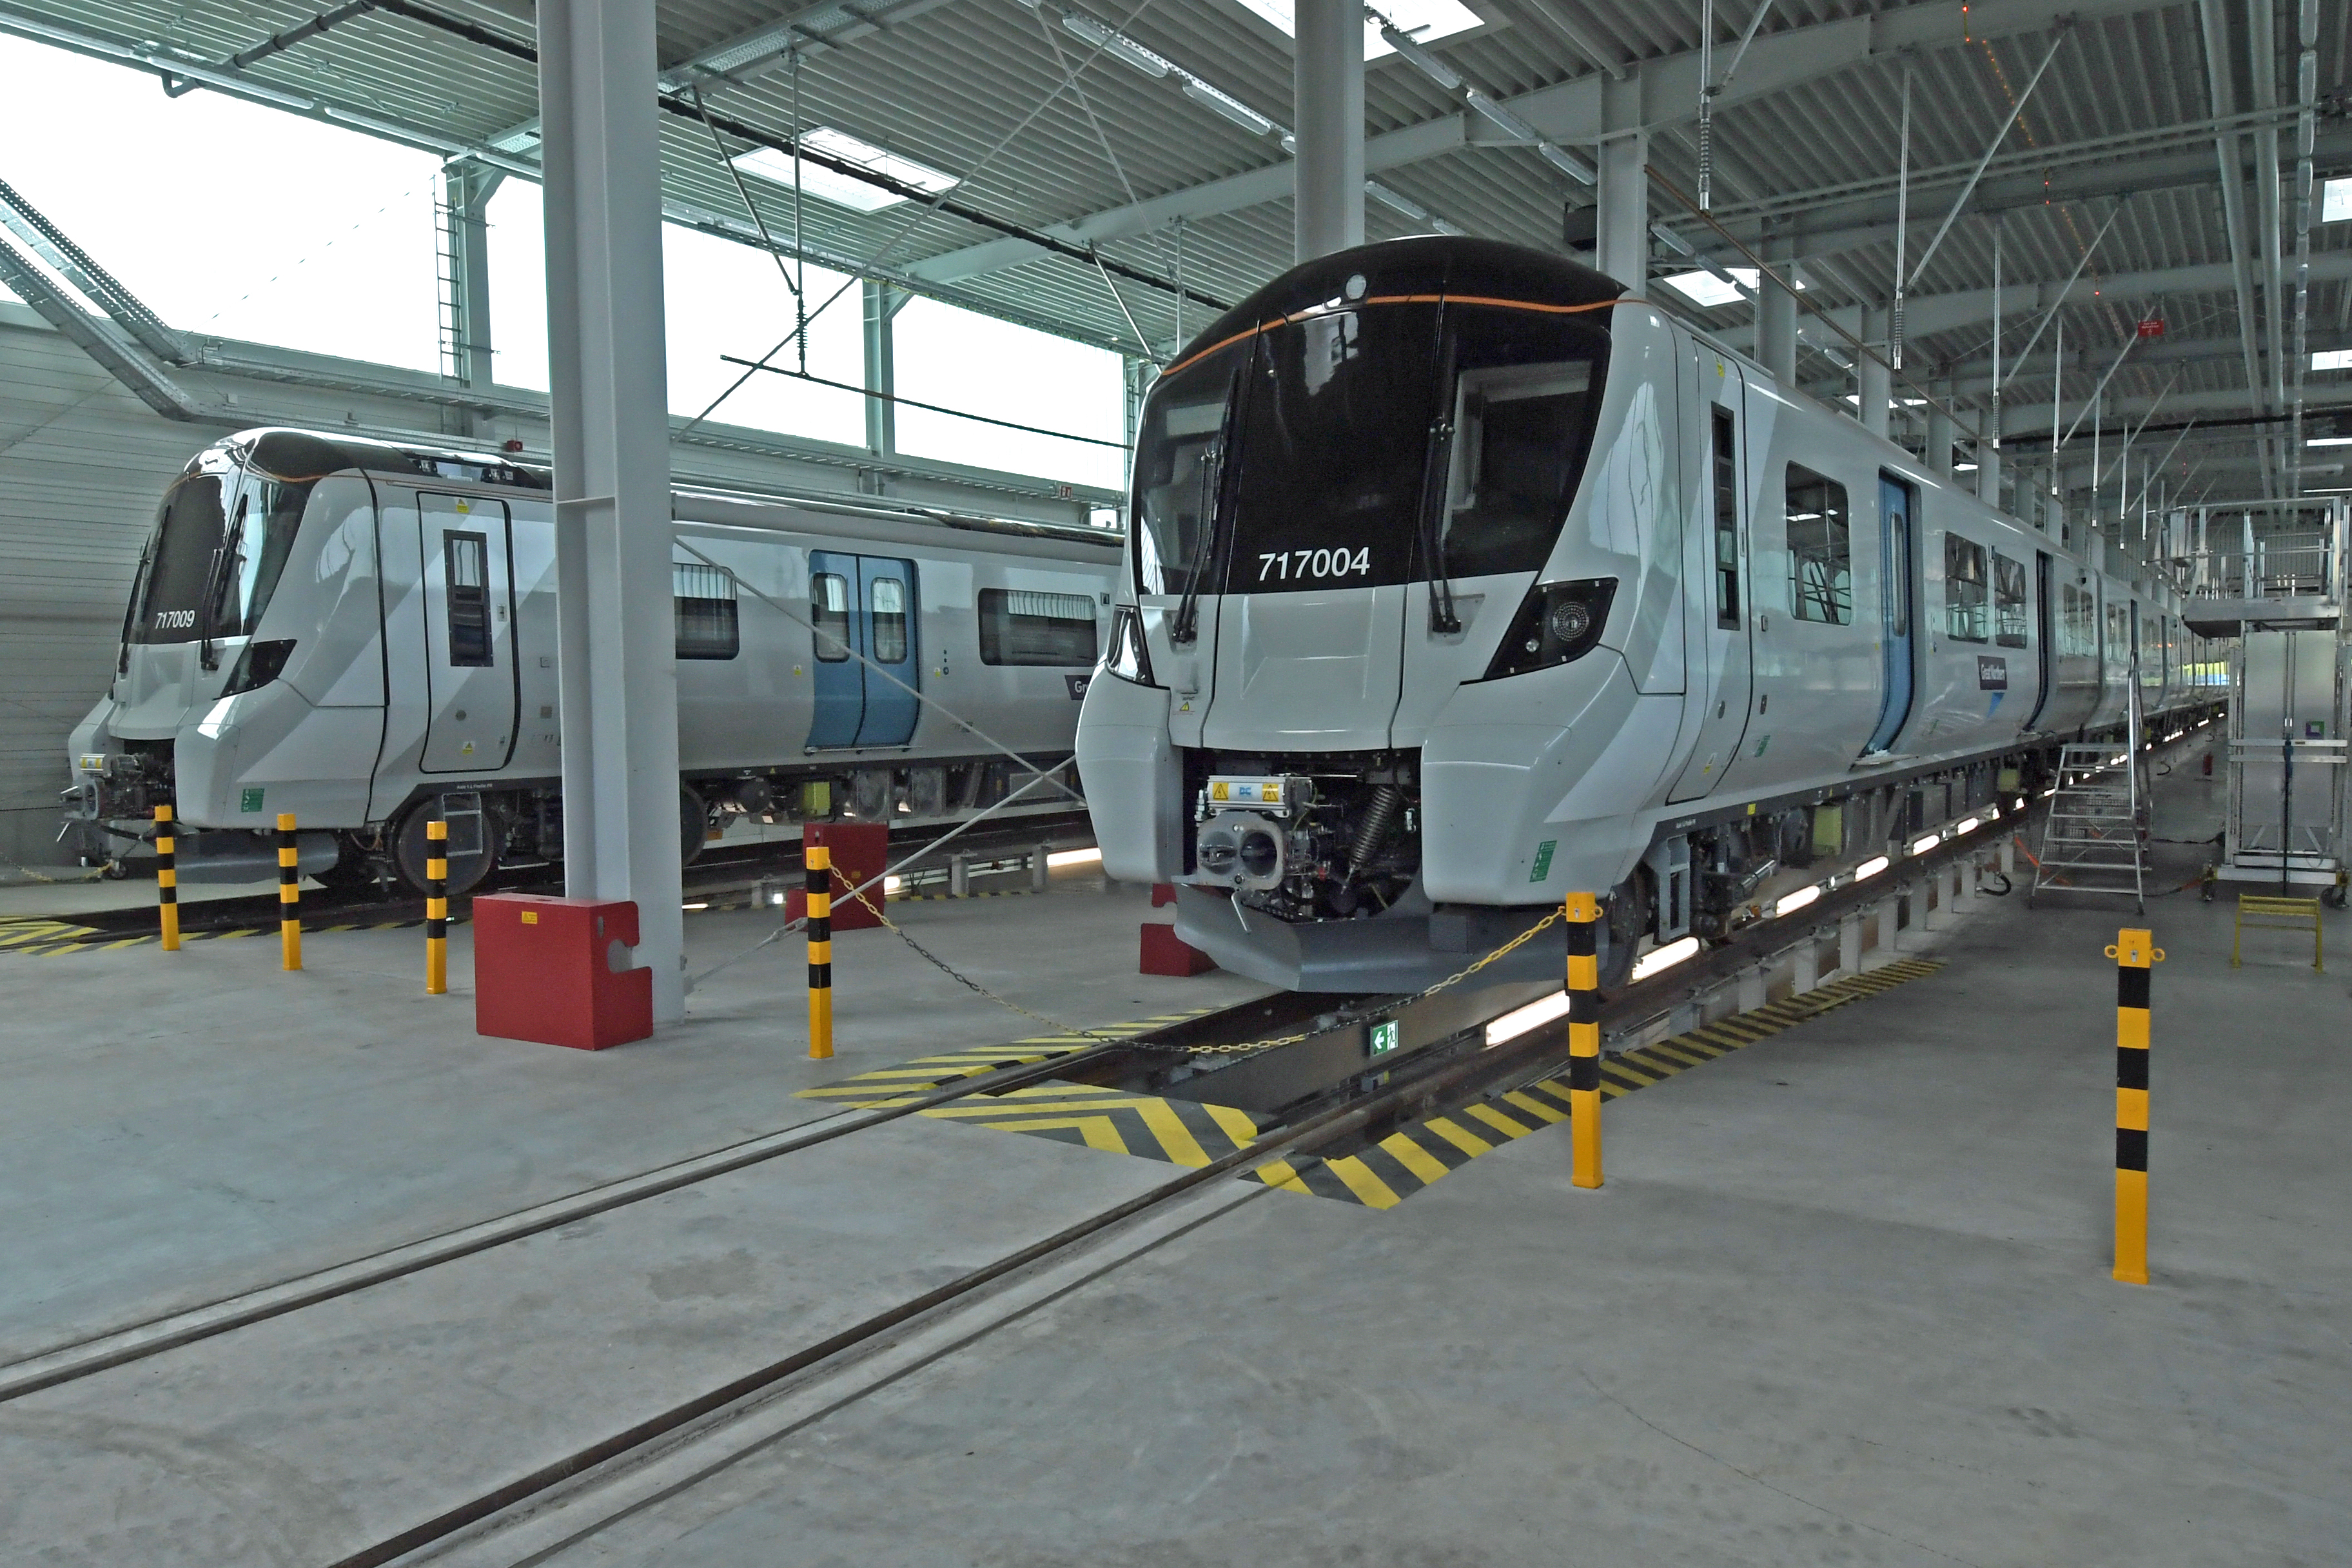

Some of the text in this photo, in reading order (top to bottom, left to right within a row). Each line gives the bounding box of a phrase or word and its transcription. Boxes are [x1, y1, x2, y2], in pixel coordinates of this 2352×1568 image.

[1259, 547, 1371, 582] 717004
[155, 609, 195, 629] 717009
[1074, 680, 1090, 694] Gr
